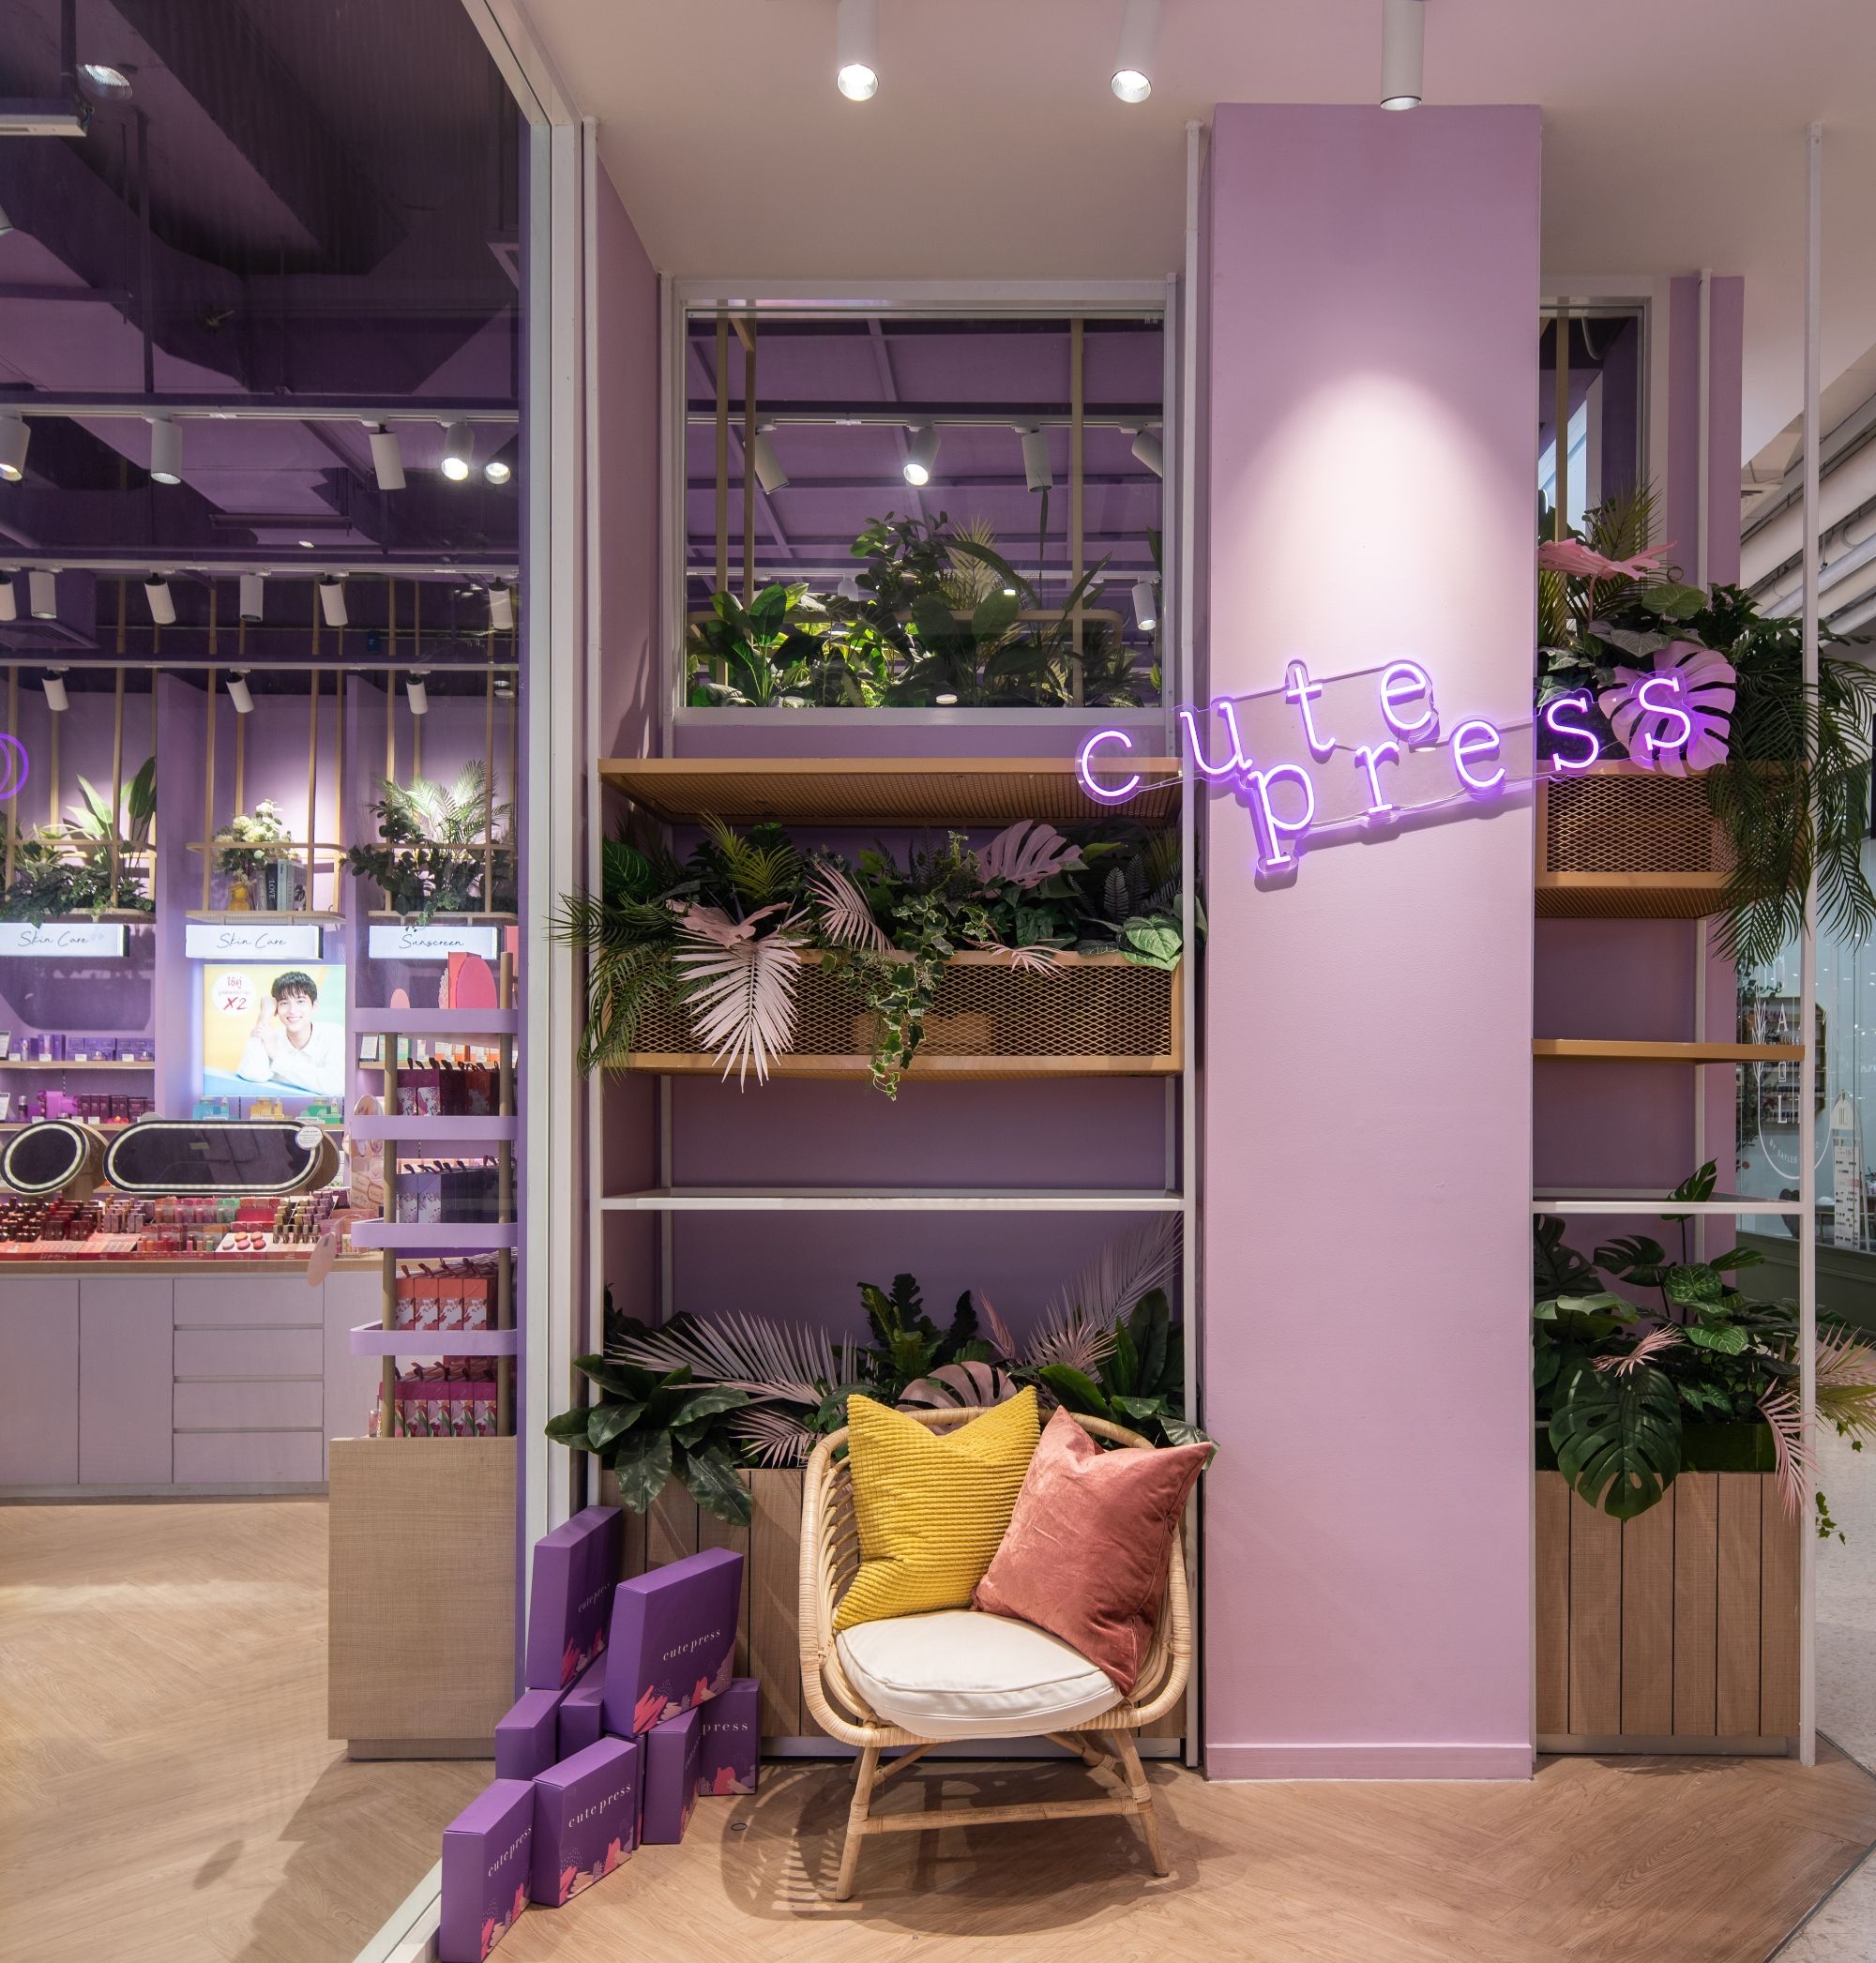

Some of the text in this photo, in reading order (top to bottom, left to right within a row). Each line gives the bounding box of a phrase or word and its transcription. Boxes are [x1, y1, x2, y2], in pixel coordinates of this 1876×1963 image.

[1080, 660, 1432, 798] cute
[1246, 675, 1691, 866] press
[18, 929, 89, 947] Skin Care
[217, 932, 286, 949] Skin Care
[399, 933, 464, 949] Sunscreen
[703, 1723, 749, 1736] press
